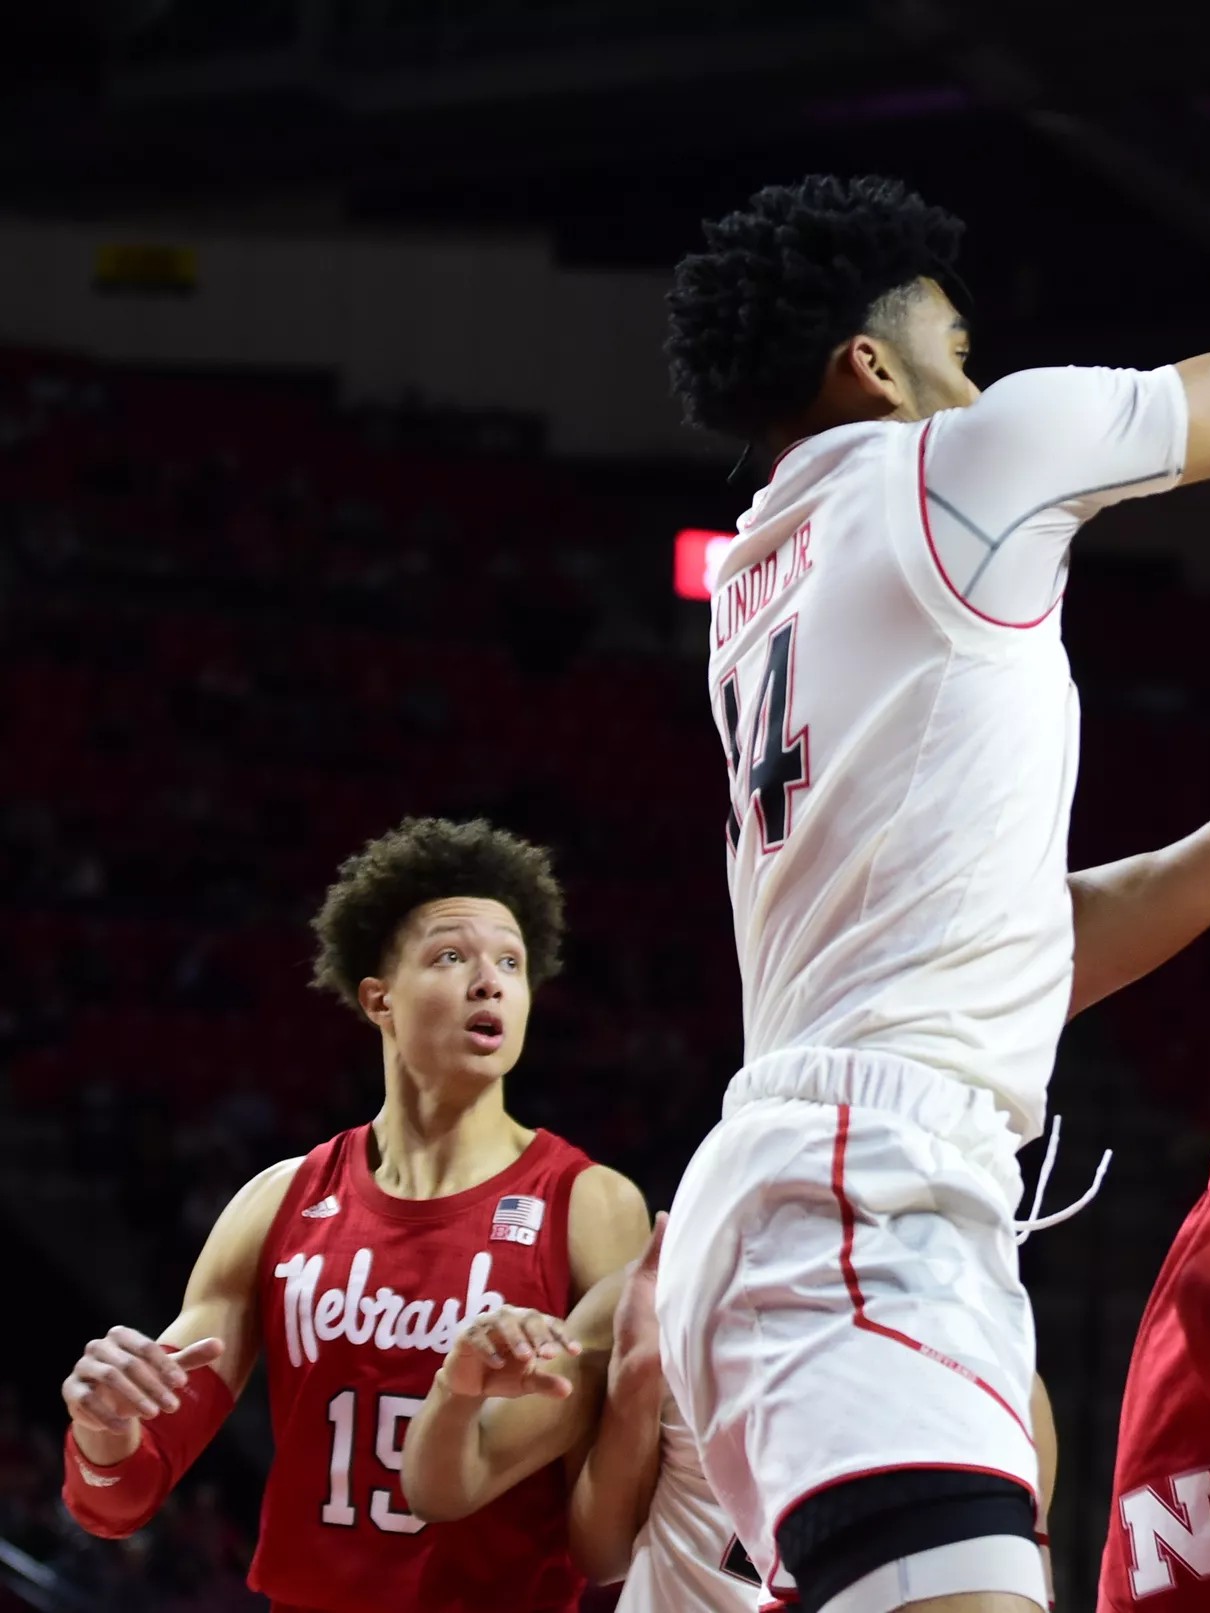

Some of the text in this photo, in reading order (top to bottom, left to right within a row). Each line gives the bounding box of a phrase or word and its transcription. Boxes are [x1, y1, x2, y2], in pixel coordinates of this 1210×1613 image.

[783, 520, 813, 590] JR
[719, 611, 810, 859] 14
[274, 1247, 504, 1368] Nebrask
[321, 1388, 428, 1535] 15
